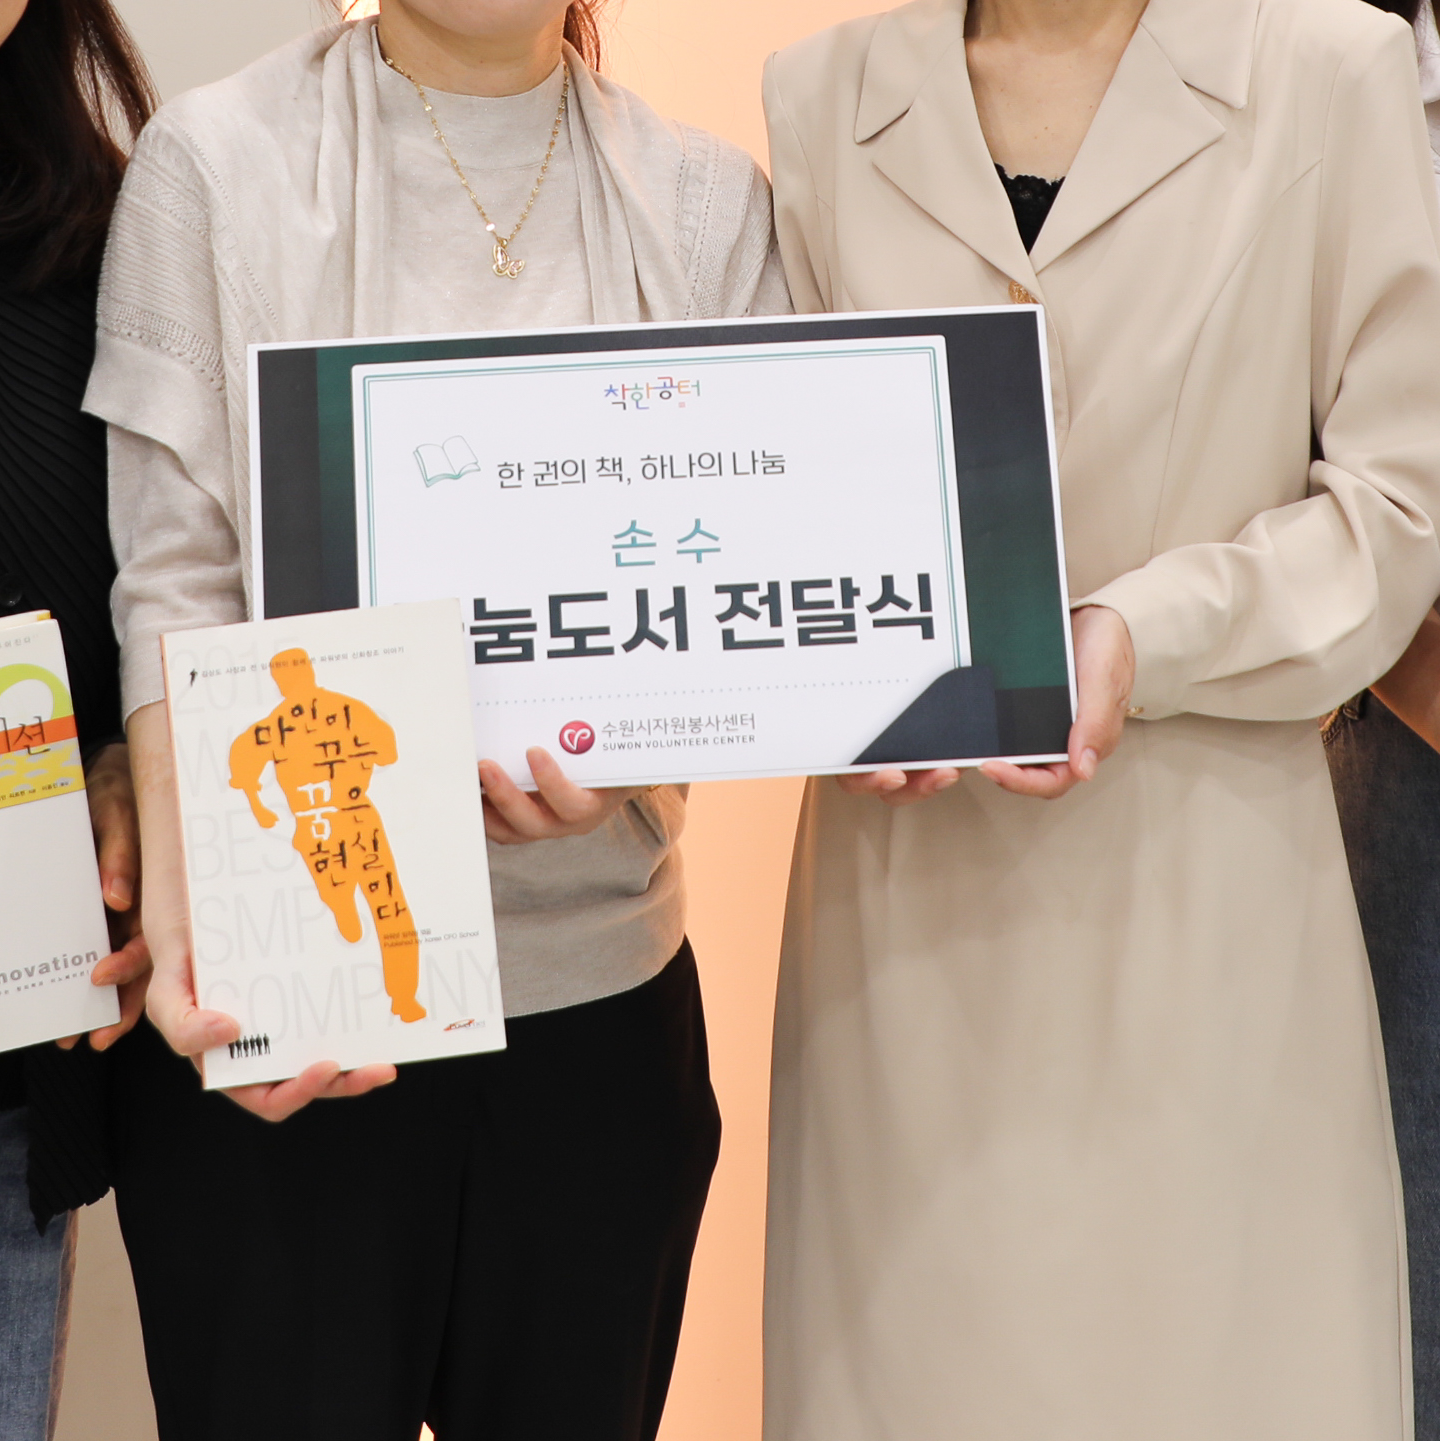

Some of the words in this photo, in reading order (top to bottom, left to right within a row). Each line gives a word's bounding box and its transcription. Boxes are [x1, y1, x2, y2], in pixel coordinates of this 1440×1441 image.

[603, 376, 701, 411] 착한공터
[496, 461, 525, 489] 한
[532, 459, 587, 488] 권의
[595, 456, 632, 486] 책,
[639, 451, 724, 481] 하나의
[731, 449, 787, 476] 나눔
[462, 585, 690, 665] 눔도서
[713, 572, 936, 651] 전달식
[383, 645, 405, 657] 이야기
[601, 712, 756, 739] 수원시자원봉사센터
[602, 740, 642, 751] SUWON
[645, 737, 709, 748] VOLUNTEER
[713, 734, 756, 746] CENTER
[313, 735, 378, 780] 꾸는
[295, 779, 371, 841] 꿈은
[459, 930, 479, 939] School
